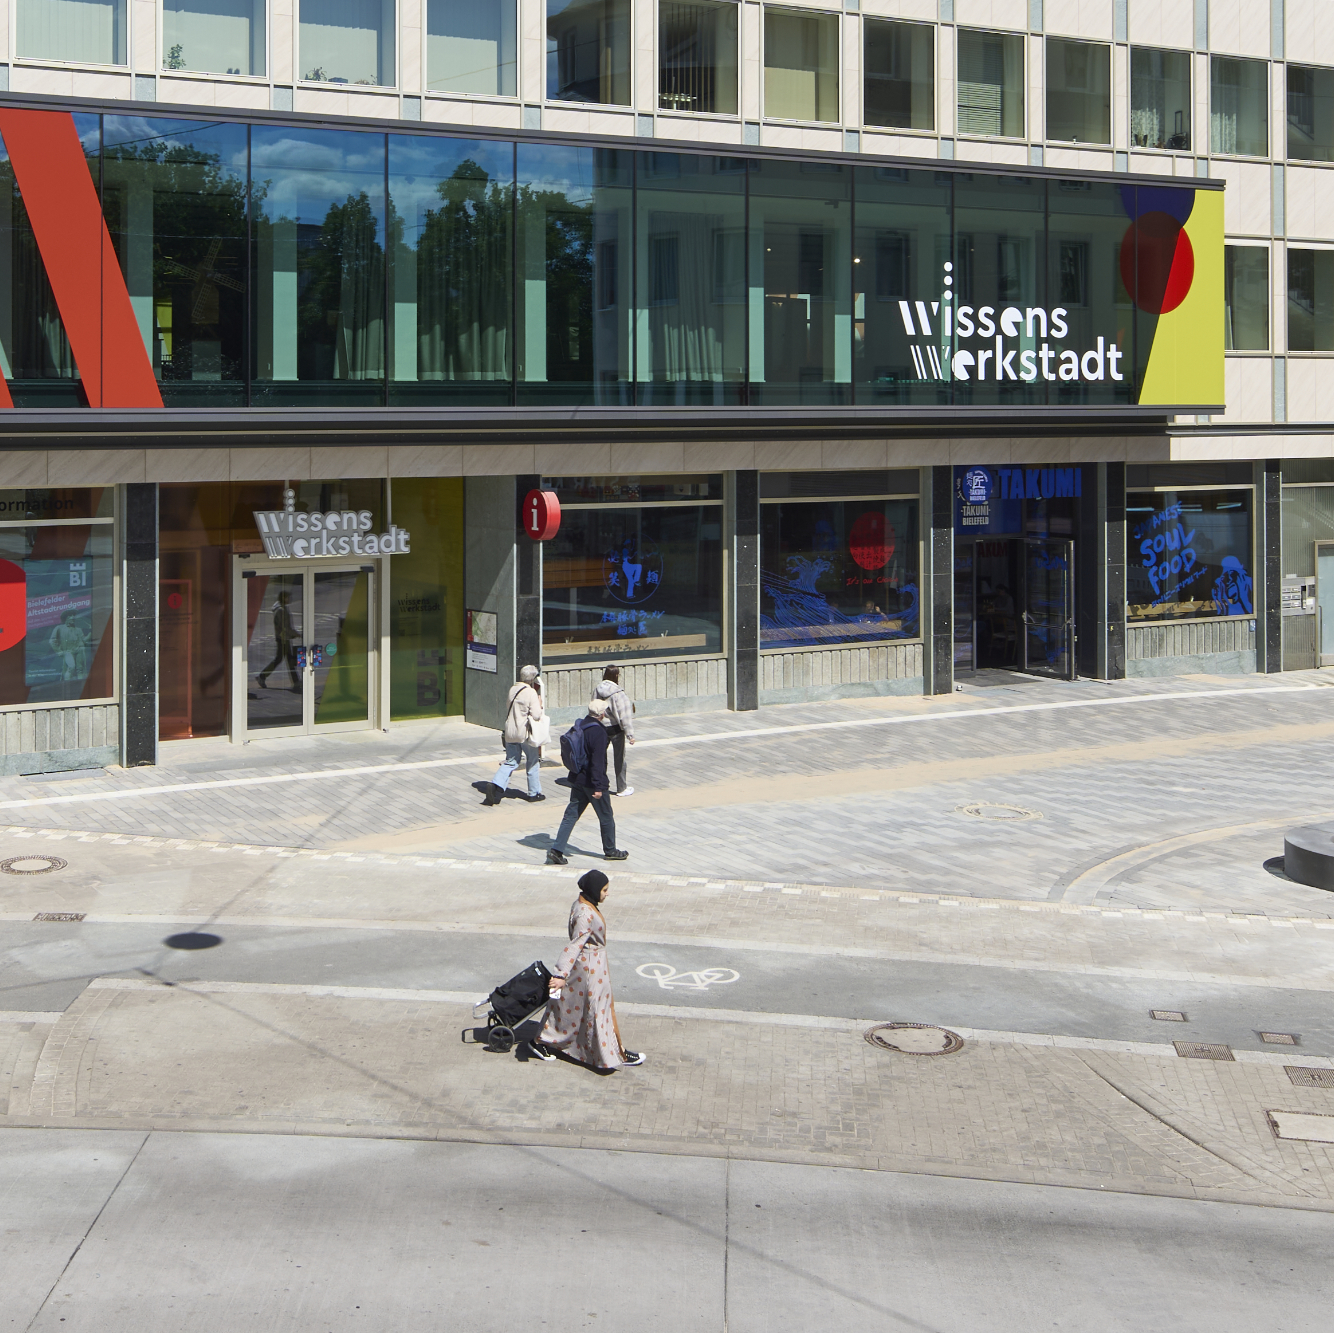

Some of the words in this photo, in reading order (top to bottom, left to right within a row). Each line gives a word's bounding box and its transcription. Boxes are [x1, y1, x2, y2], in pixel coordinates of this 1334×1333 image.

[898, 261, 1068, 338] Wissens
[910, 335, 1123, 380] Werkstadt
[998, 468, 1082, 499] TAKUMI
[257, 489, 373, 533] Wissens
[962, 517, 989, 526] BIELEFELD
[1133, 501, 1183, 539] JAPANESE
[266, 525, 410, 558] Werkstadt
[1140, 523, 1195, 567] SOUL
[1148, 548, 1197, 595] FOOD
[27, 595, 66, 609] Bielefelder
[27, 599, 91, 617] Altstadtrundgang
[397, 593, 430, 606] Wissens
[400, 603, 441, 613] Werkstadt
